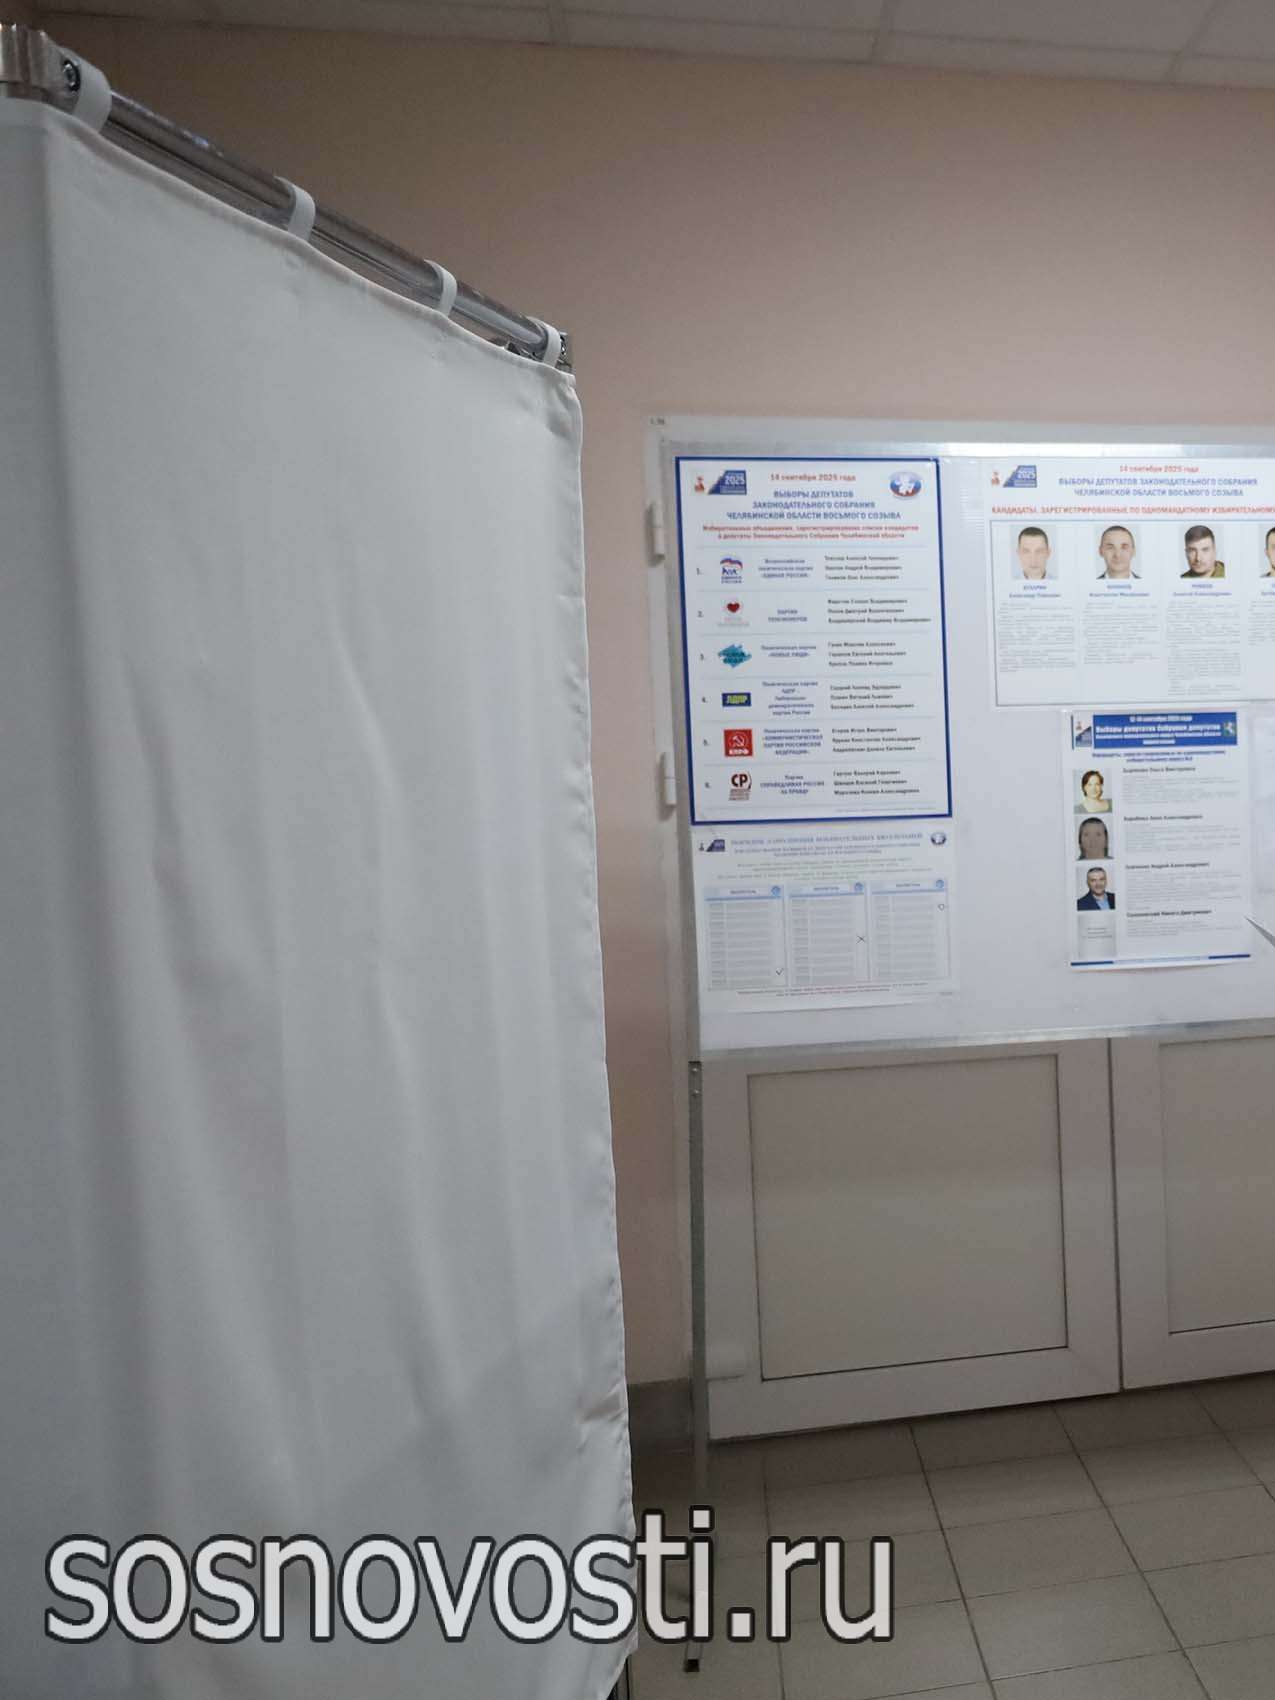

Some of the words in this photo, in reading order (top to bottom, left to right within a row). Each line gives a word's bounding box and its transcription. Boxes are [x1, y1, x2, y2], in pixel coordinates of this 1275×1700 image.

[724, 475, 745, 485] 2025
[781, 474, 816, 482] сентября
[839, 474, 856, 482] года
[773, 490, 809, 498] ВЫБОРЫ
[810, 490, 854, 498] ДЕПУТАТОВ
[752, 501, 832, 510] ЗАКОНОДАТЕЛЬНОГО
[833, 501, 875, 510] СОБРАНИЯ
[727, 511, 785, 520] ЧЕЛЯБИНСКОЙ
[786, 511, 822, 520] ОБЛАСТИ
[823, 511, 866, 520] ВОСЬМОГО
[867, 511, 901, 520] СОЗЫВА
[731, 773, 748, 788] СР
